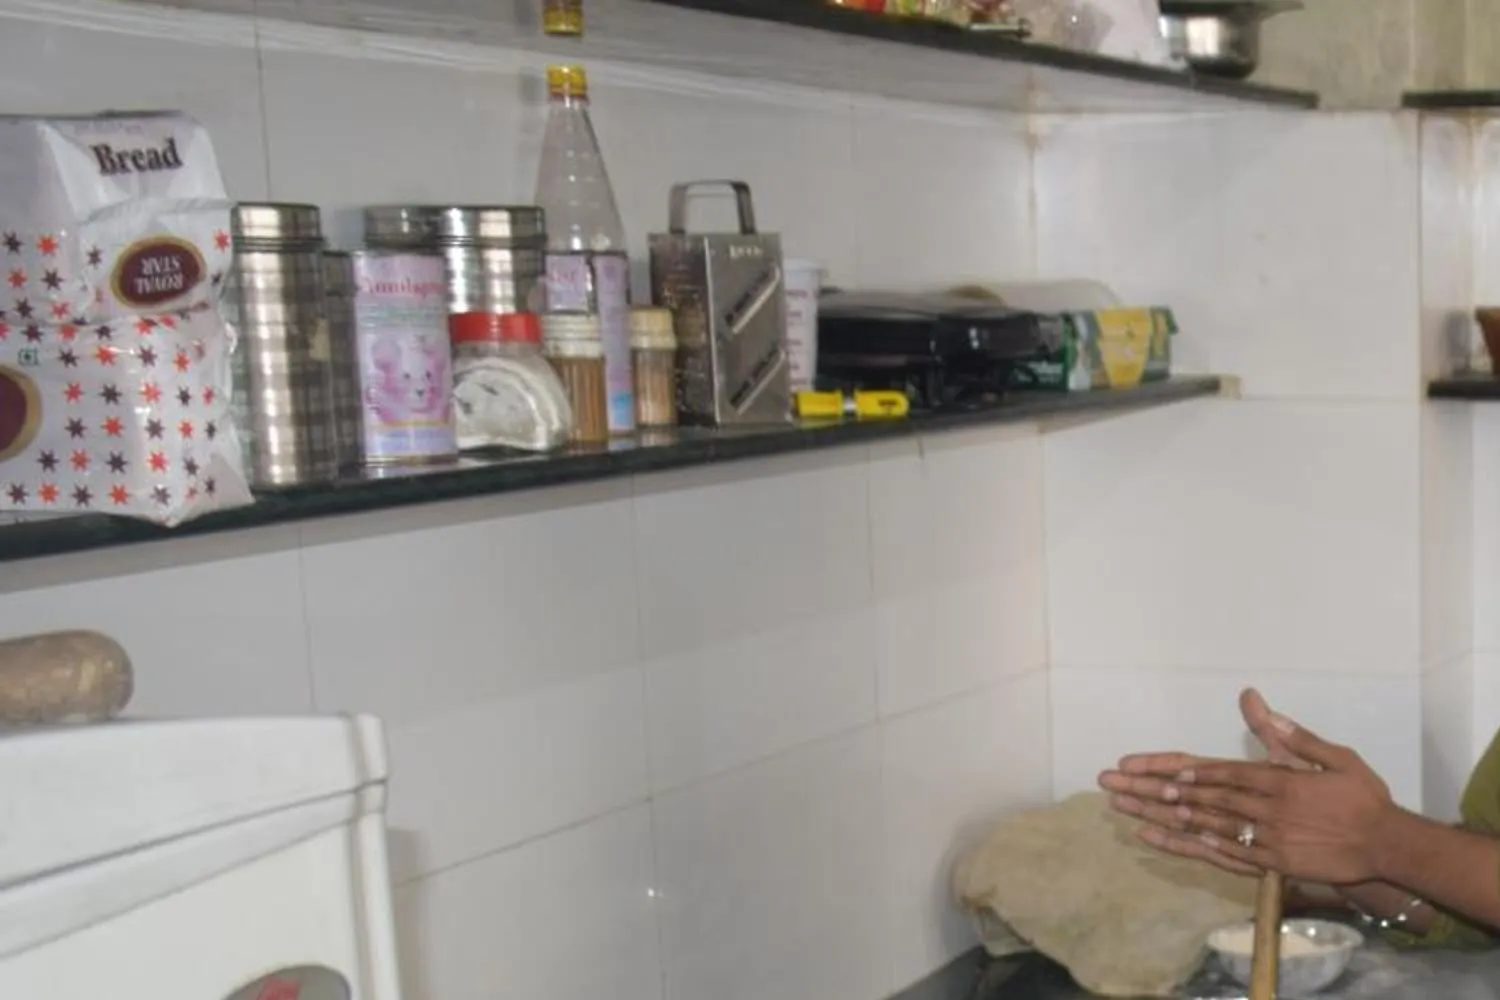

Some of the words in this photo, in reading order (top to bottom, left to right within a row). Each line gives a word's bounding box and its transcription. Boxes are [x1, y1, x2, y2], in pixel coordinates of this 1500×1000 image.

[91, 137, 184, 175] Bread
[142, 255, 180, 275] STAR
[134, 272, 183, 294] ROYAL
